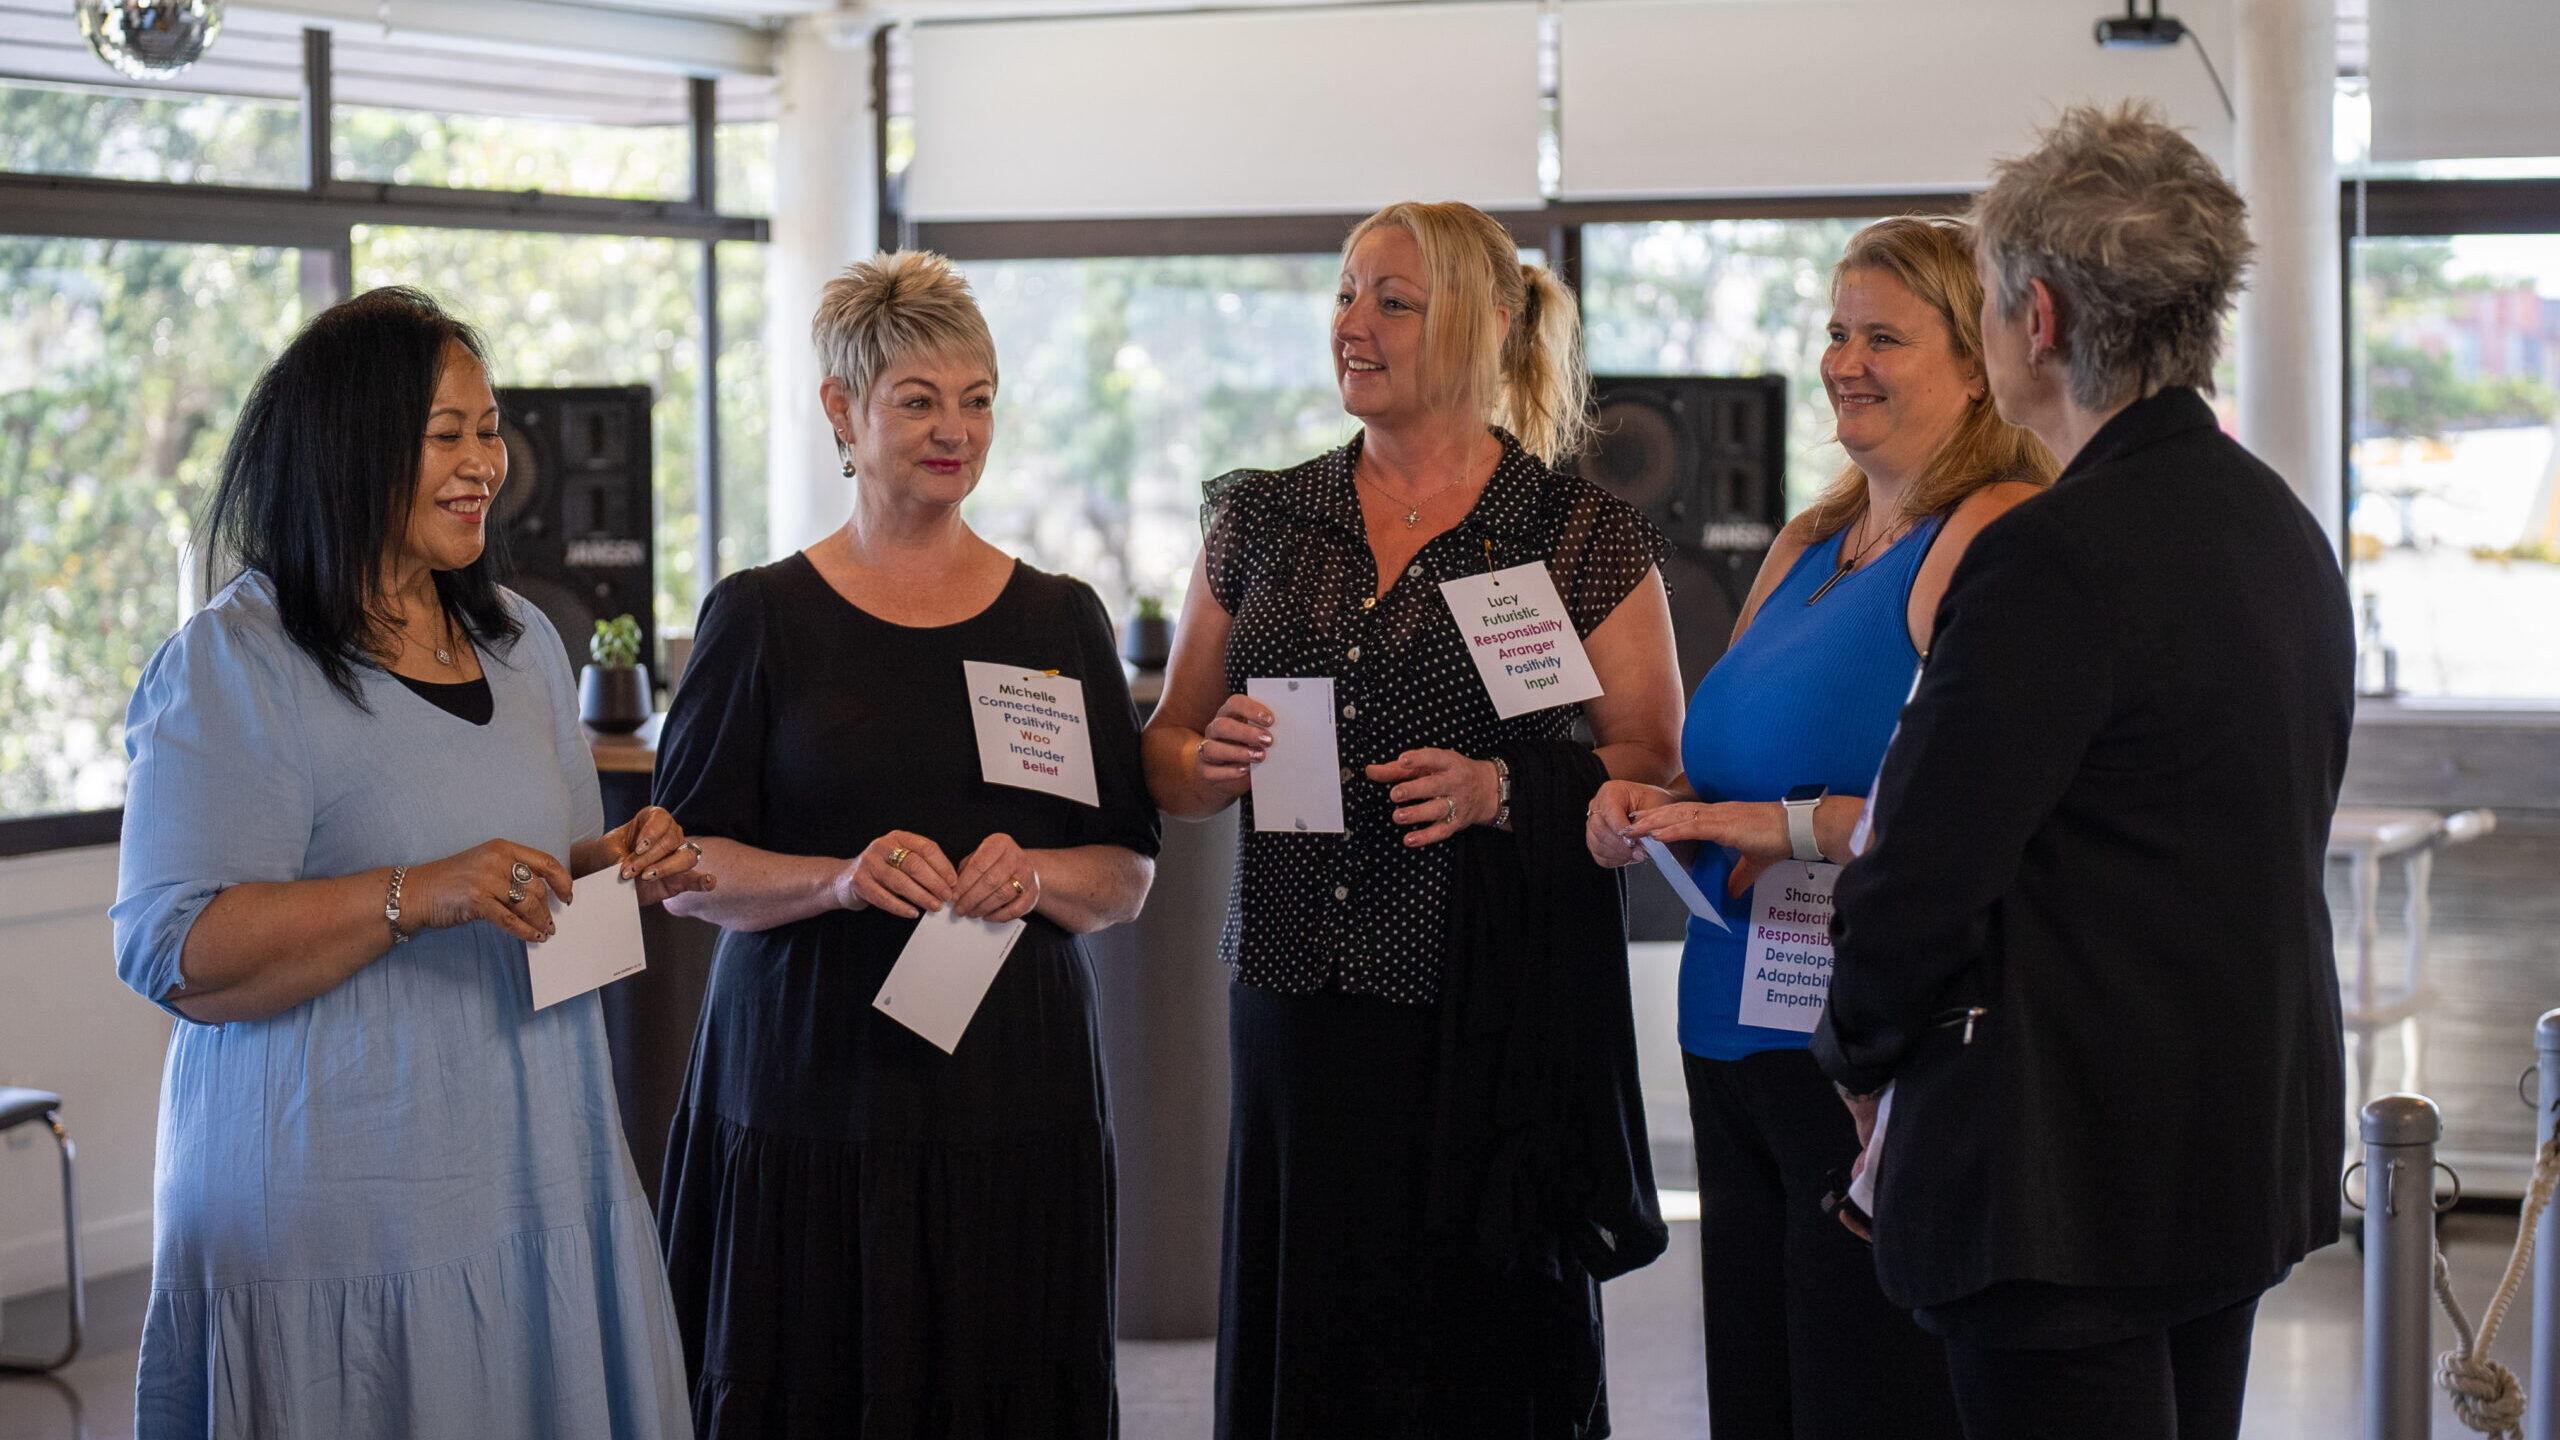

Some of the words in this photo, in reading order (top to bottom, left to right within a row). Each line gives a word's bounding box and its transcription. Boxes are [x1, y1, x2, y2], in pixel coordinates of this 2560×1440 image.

[1487, 594, 1518, 608] Lucy
[1481, 607, 1540, 627] Futuristic
[1473, 619, 1563, 647] Responsibility
[1499, 639, 1555, 660] Arranger
[1505, 656, 1562, 676] Positivity
[1524, 673, 1560, 690] Input
[999, 684, 1057, 704] Michelle
[978, 695, 1081, 724] Connectedness
[1004, 713, 1061, 735] Positivity
[1020, 729, 1051, 745] Woo
[1010, 743, 1065, 763] Includer
[1022, 759, 1059, 776] Belief
[1768, 906, 1832, 925] Restorati
[1757, 926, 1834, 946] Responsib
[1765, 948, 1836, 969] Develope
[1756, 967, 1832, 988] Adaptabil
